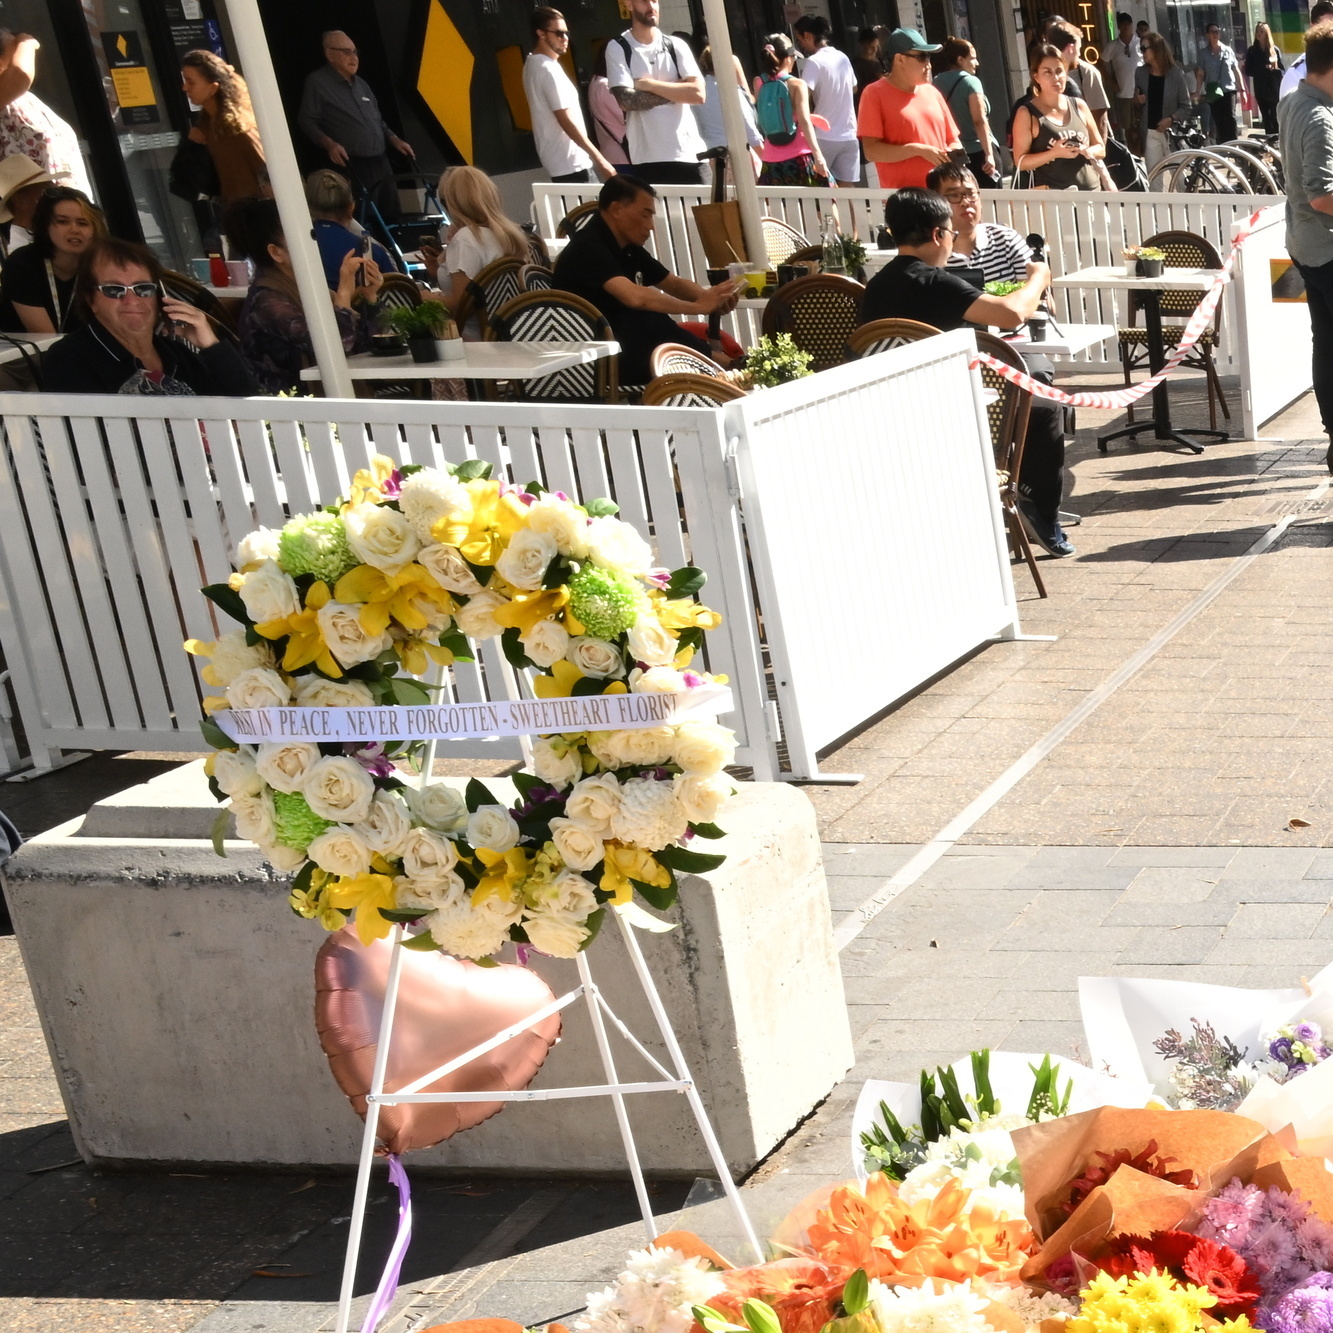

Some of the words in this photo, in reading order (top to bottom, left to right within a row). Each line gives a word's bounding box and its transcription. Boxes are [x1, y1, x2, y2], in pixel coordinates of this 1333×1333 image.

[257, 710, 273, 736] IN
[346, 710, 400, 735] NEVER
[617, 693, 678, 723] FLORIST
